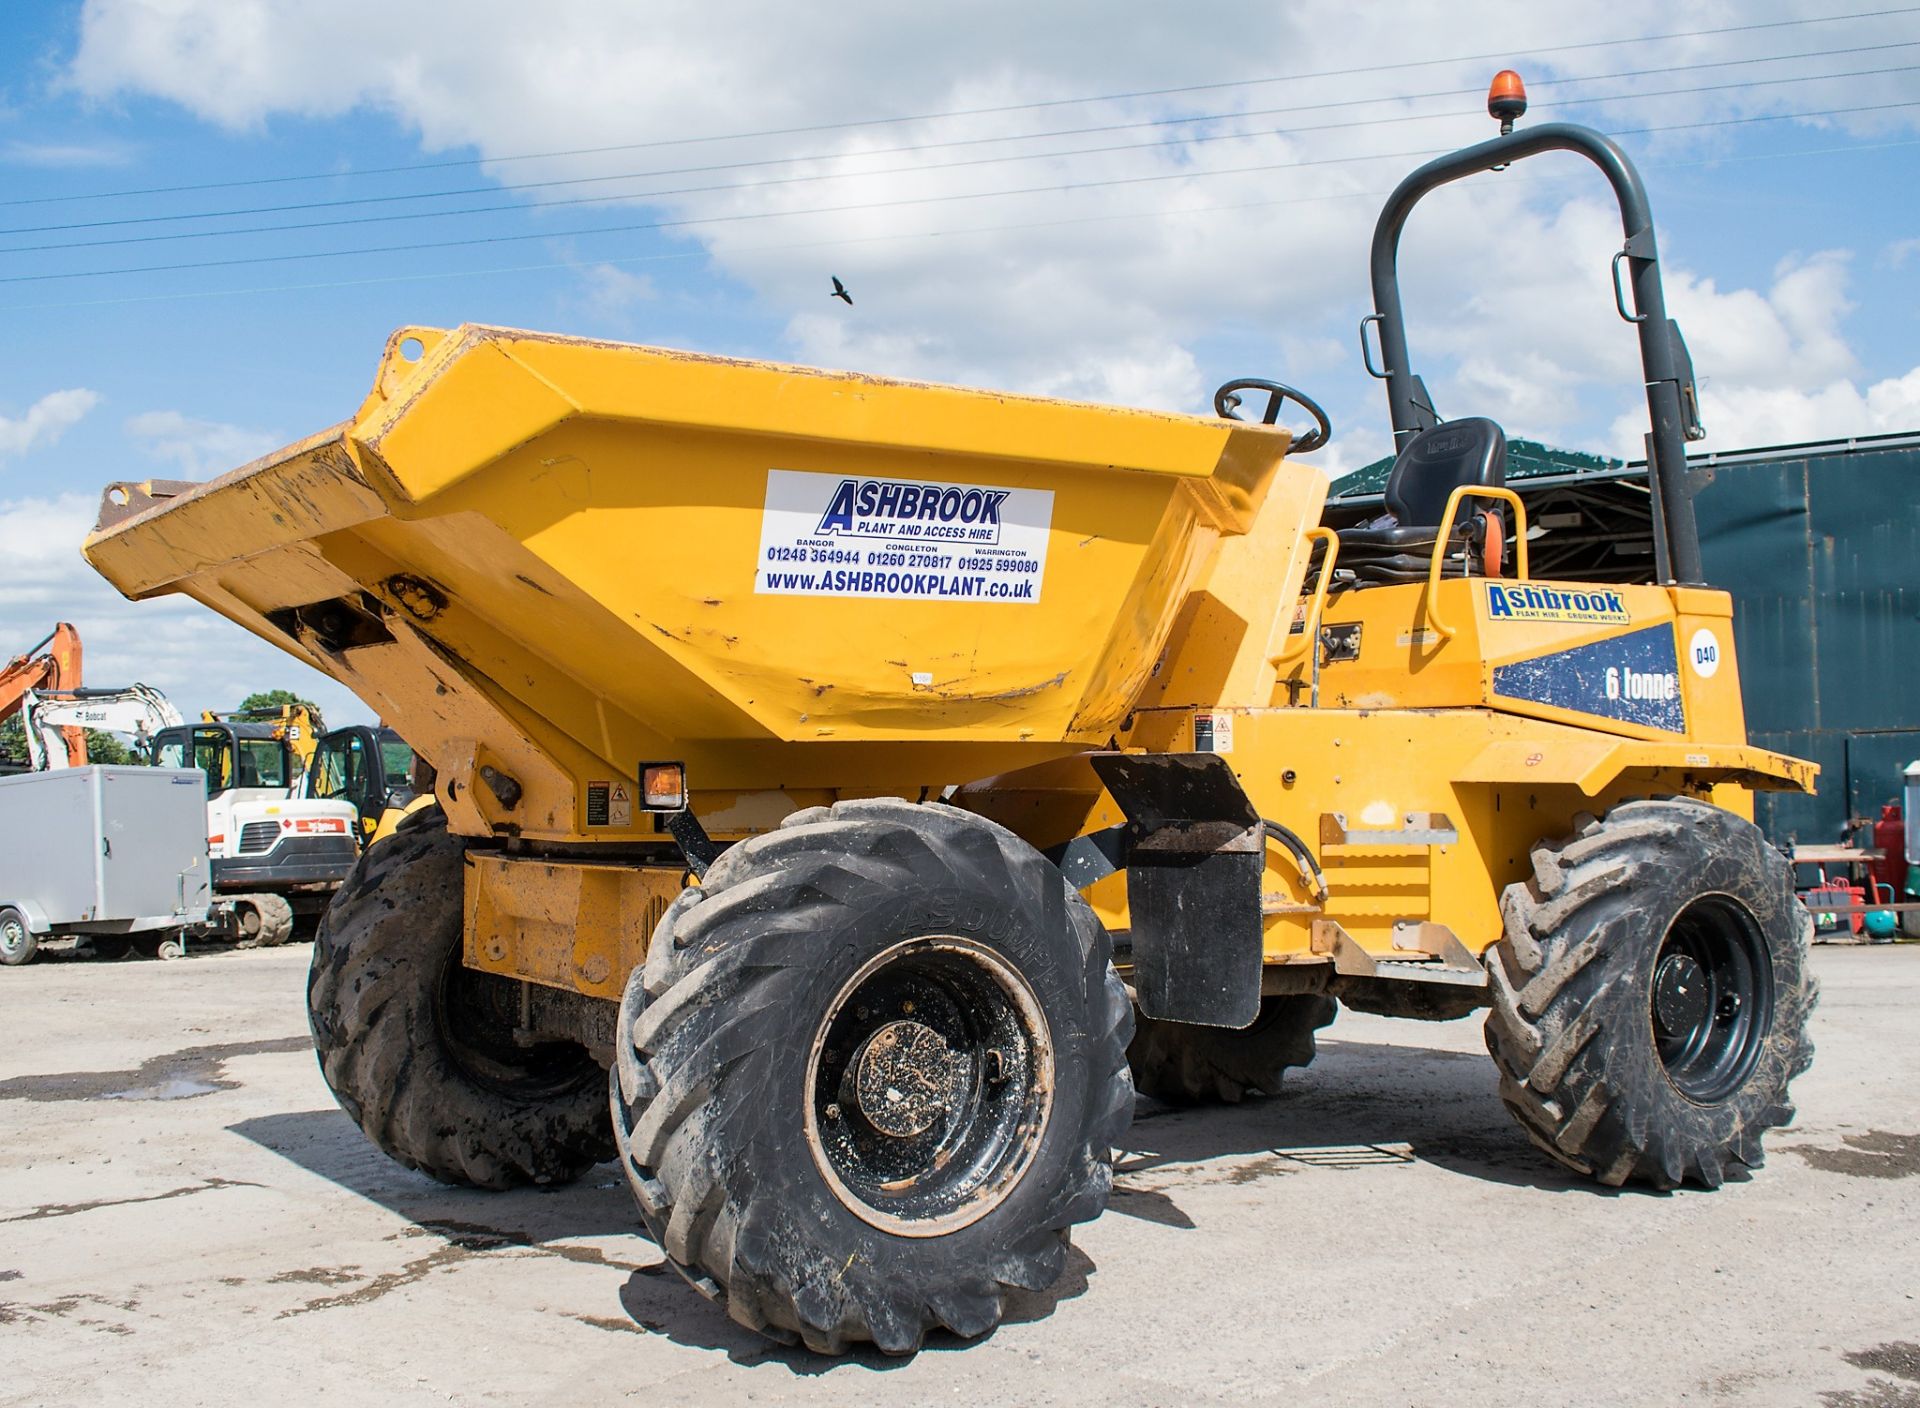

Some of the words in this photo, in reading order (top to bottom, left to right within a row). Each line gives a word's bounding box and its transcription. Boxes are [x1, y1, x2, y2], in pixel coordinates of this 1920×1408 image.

[821, 482, 1005, 530] ASHBROOK
[857, 521, 896, 535] PLANT
[898, 525, 922, 536] AND
[924, 526, 966, 539] ACCESS
[968, 528, 994, 540] HIRE
[796, 538, 835, 547] BANGOR
[885, 543, 938, 553] CONGLETON
[975, 548, 1027, 557] WARRINGTON
[767, 547, 807, 561] 01248
[811, 549, 860, 564] 364944
[868, 552, 905, 566] 01260
[909, 554, 952, 569] 270817
[958, 557, 993, 571] 01925
[996, 560, 1038, 573] 599080
[1489, 586, 1624, 617] Ashbrook
[1516, 610, 1540, 618] PLANT
[1543, 611, 1560, 619] HIRE
[1567, 612, 1598, 620] GROUND
[1696, 645, 1716, 665] D40
[1606, 667, 1620, 700] 6
[1623, 667, 1675, 700] tonne
[85, 711, 107, 721] Bobcat
